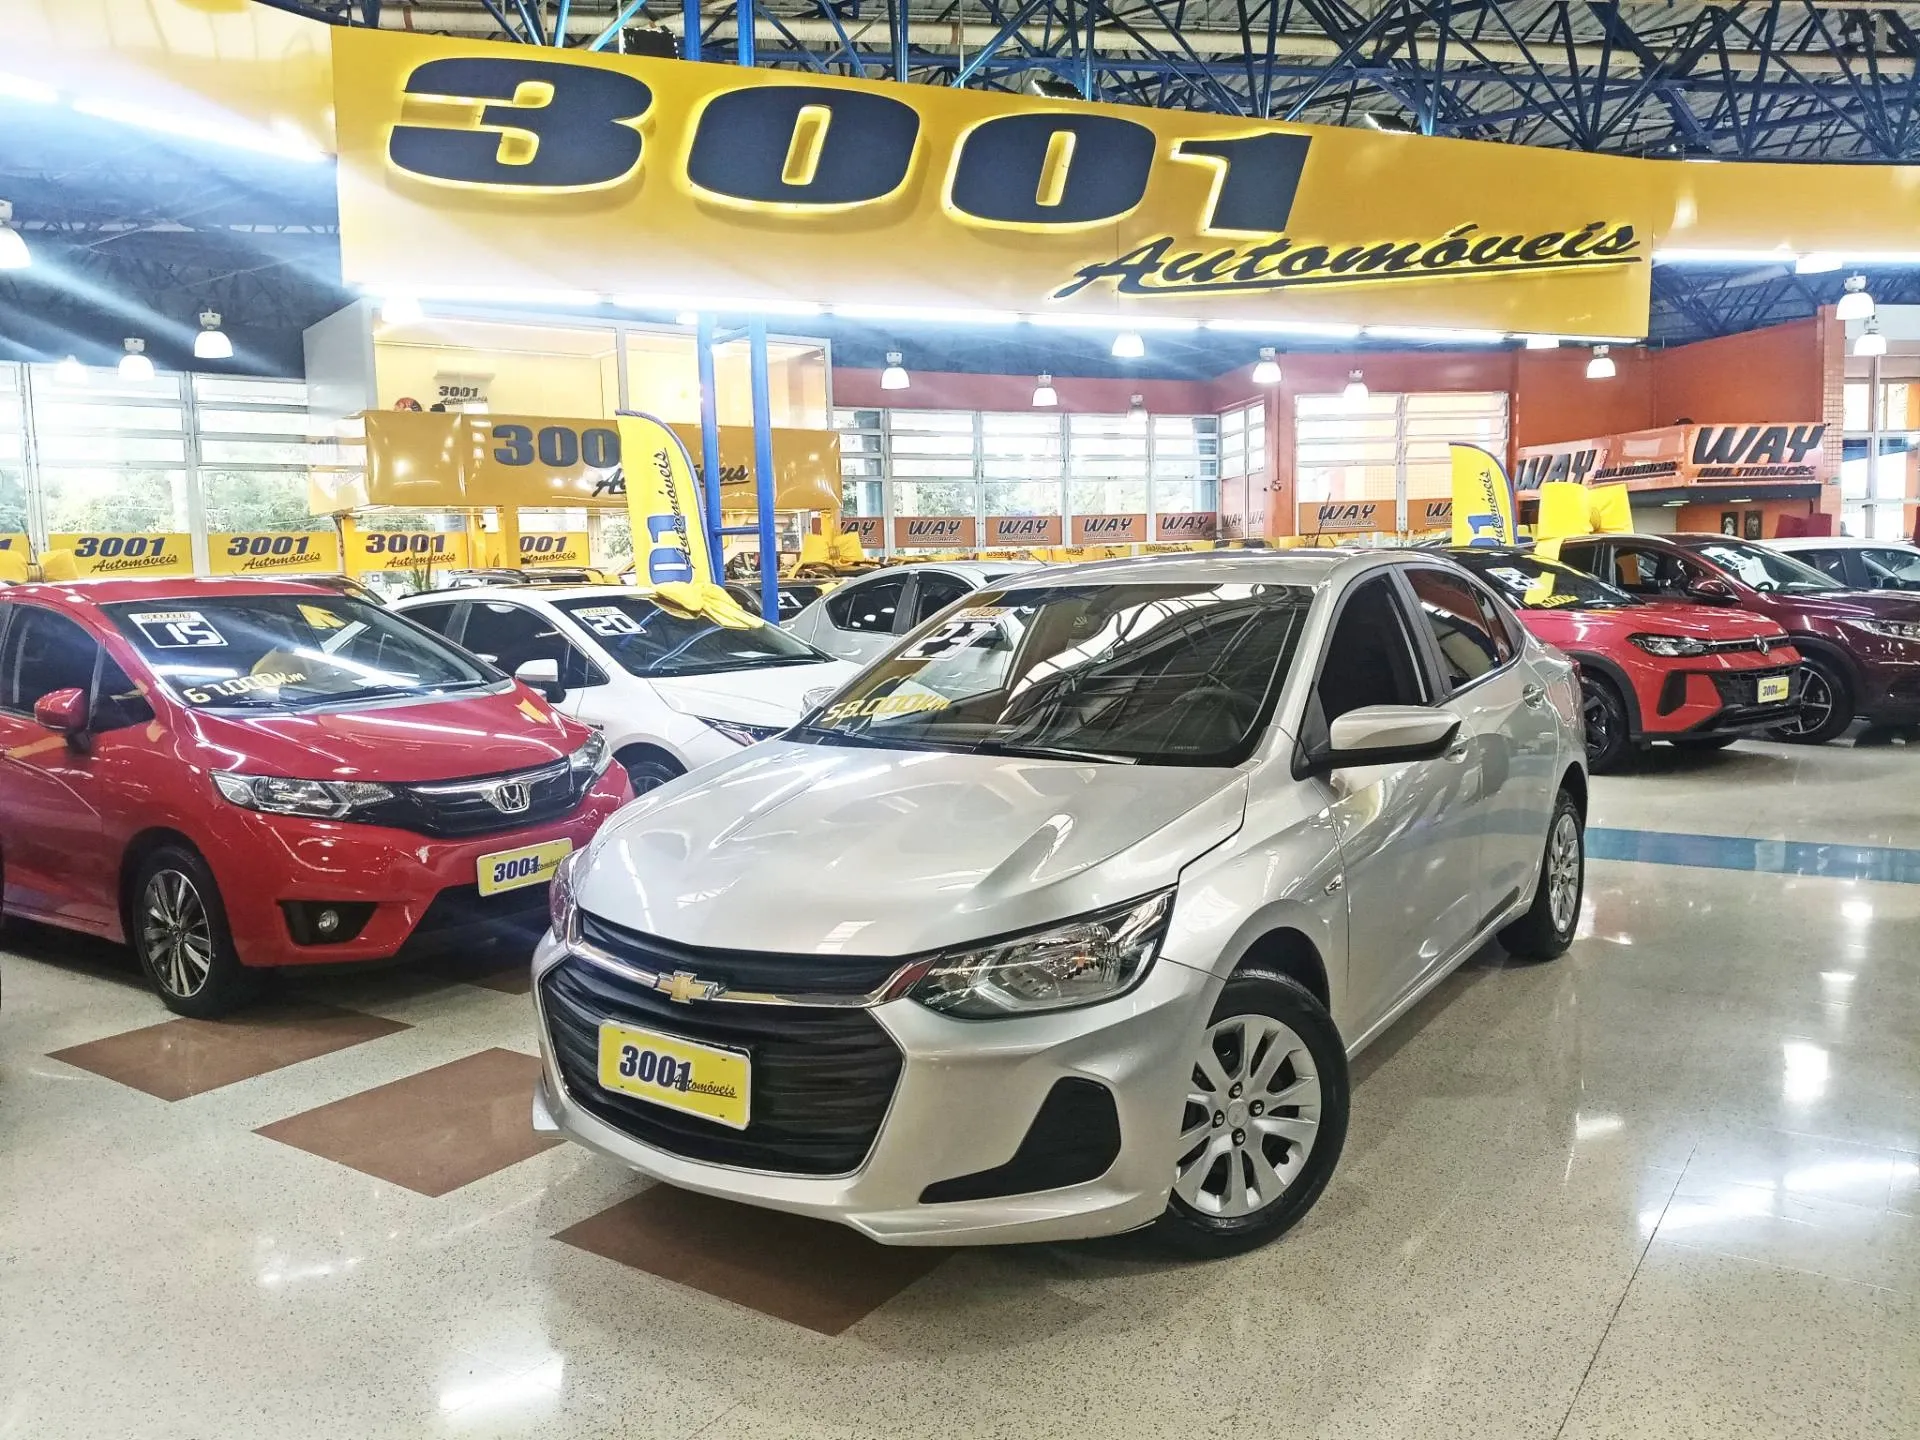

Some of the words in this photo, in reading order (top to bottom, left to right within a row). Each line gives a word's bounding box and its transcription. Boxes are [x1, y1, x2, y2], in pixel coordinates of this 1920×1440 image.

[389, 57, 1313, 233] 3001
[1054, 222, 1641, 298] Automóveis
[439, 386, 479, 398] 3001
[493, 424, 619, 467] 300
[1692, 426, 1827, 465] WAY
[1515, 449, 1597, 490] WAY
[654, 448, 696, 569] Automóveis
[1318, 503, 1376, 520] WAY
[908, 520, 961, 535] WAY
[998, 520, 1048, 534] WAY
[1084, 518, 1133, 532] WAY
[1161, 516, 1209, 529] WAY
[75, 537, 166, 557] 3001
[227, 536, 310, 556] 3001
[365, 534, 445, 553] 3001
[520, 535, 567, 553] 001
[647, 515, 693, 584] 01
[90, 554, 178, 573] Automóveis
[242, 551, 322, 571] Automóveis
[527, 551, 578, 564] tomóveis
[165, 622, 221, 645] 15
[584, 615, 641, 634] 20
[493, 855, 540, 882] 3001
[620, 1045, 691, 1093] 3001
[672, 1072, 738, 1099] Atomóveis
